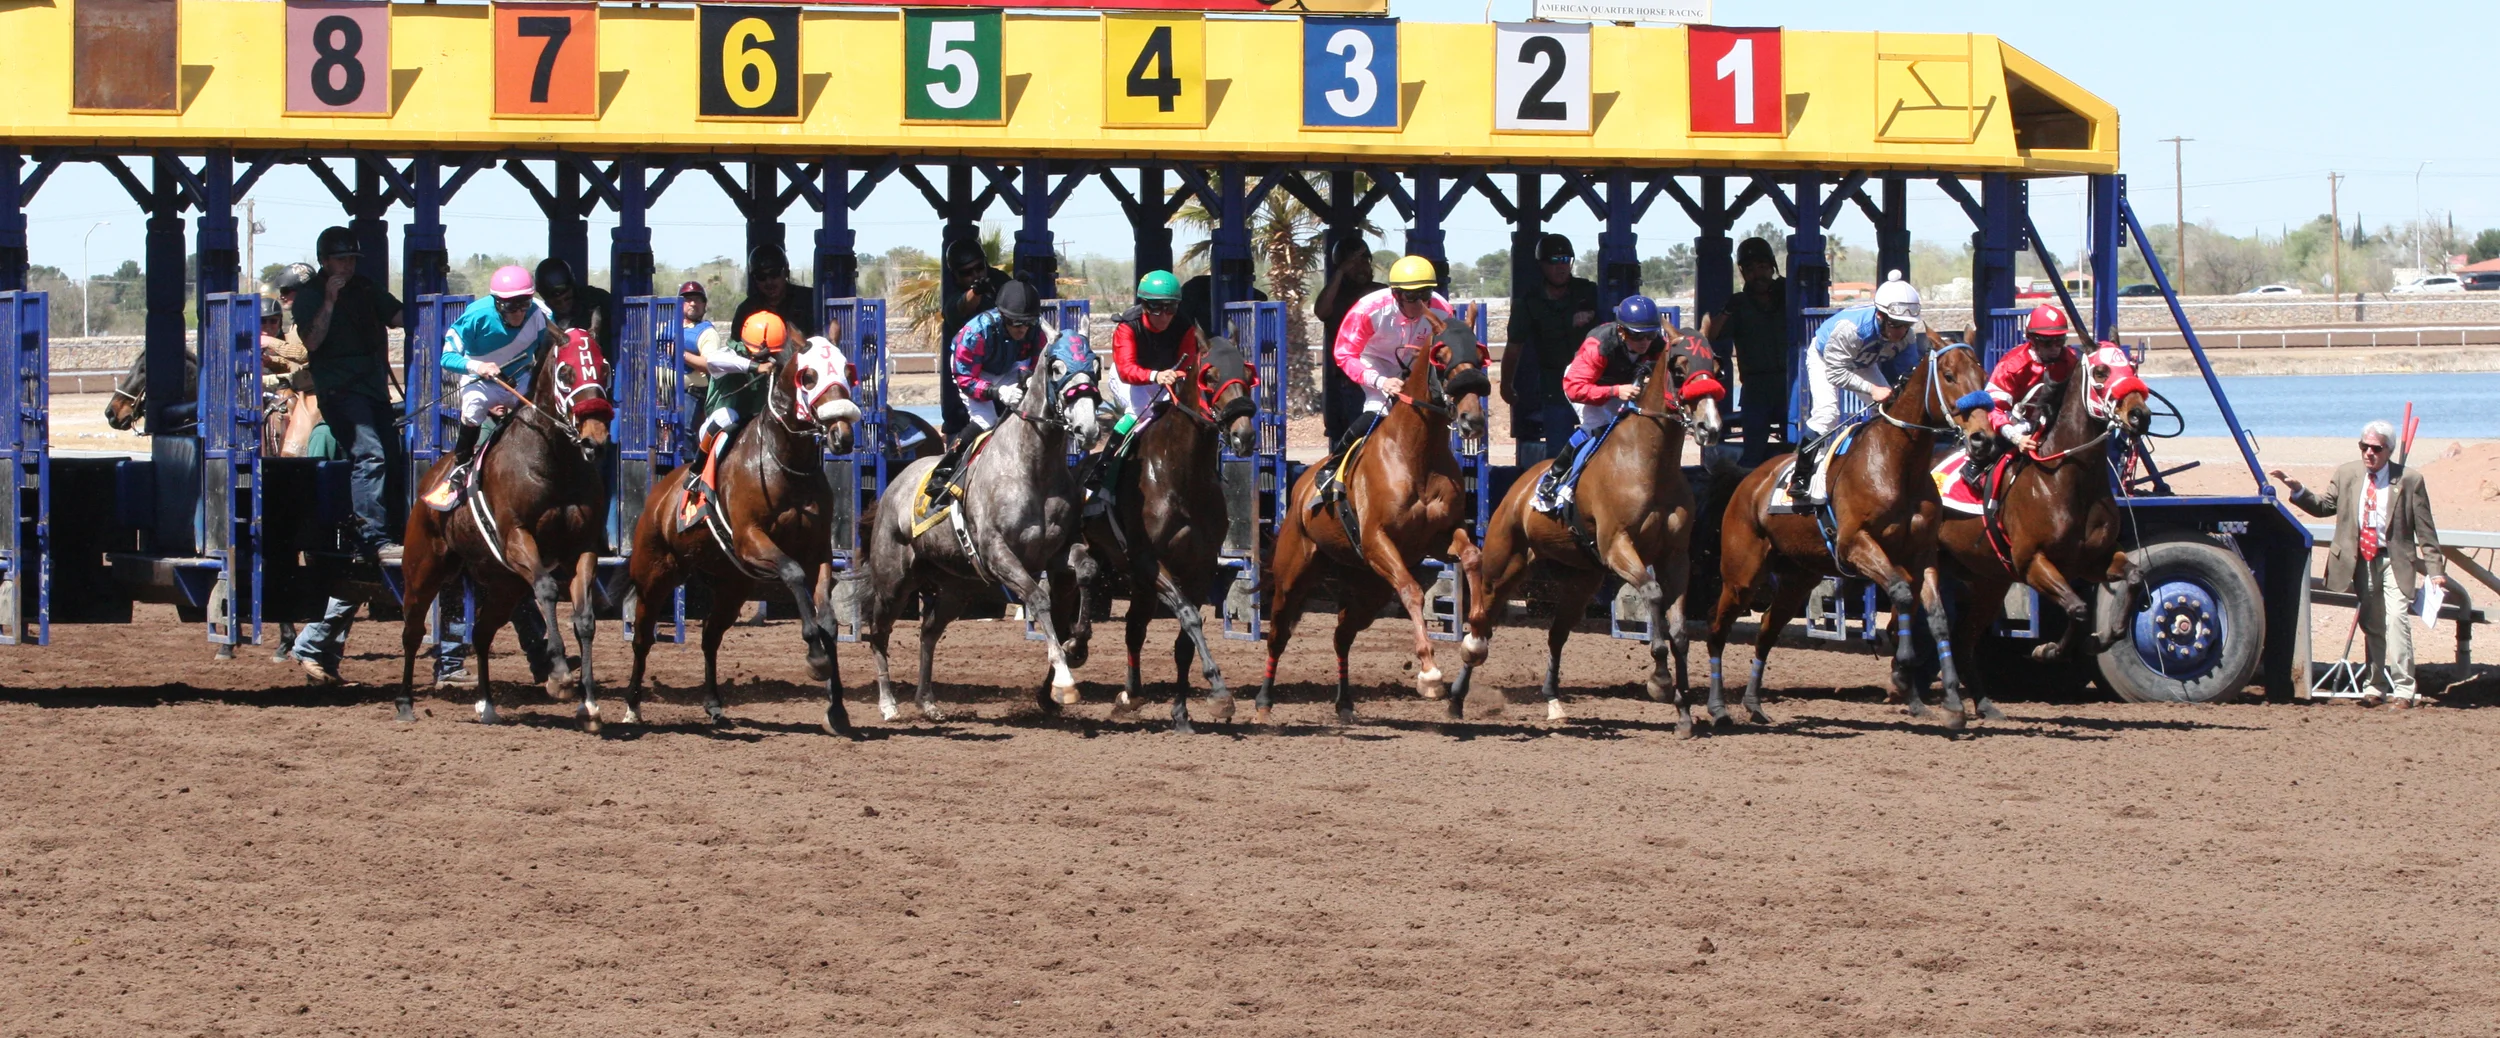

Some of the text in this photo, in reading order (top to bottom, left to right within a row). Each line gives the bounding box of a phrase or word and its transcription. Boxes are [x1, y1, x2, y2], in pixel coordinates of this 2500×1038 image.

[1540, 4, 1704, 18] AMERICAN QUARTER HORSE RACING
[311, 15, 365, 106] 8
[517, 17, 571, 103] 7
[722, 17, 777, 109] 6
[925, 20, 979, 109] 5
[1126, 26, 1182, 113] 4
[1325, 29, 1378, 118] 3
[1517, 36, 1567, 121] 2
[1716, 38, 1754, 124] 1
[578, 336, 597, 381] JHM
